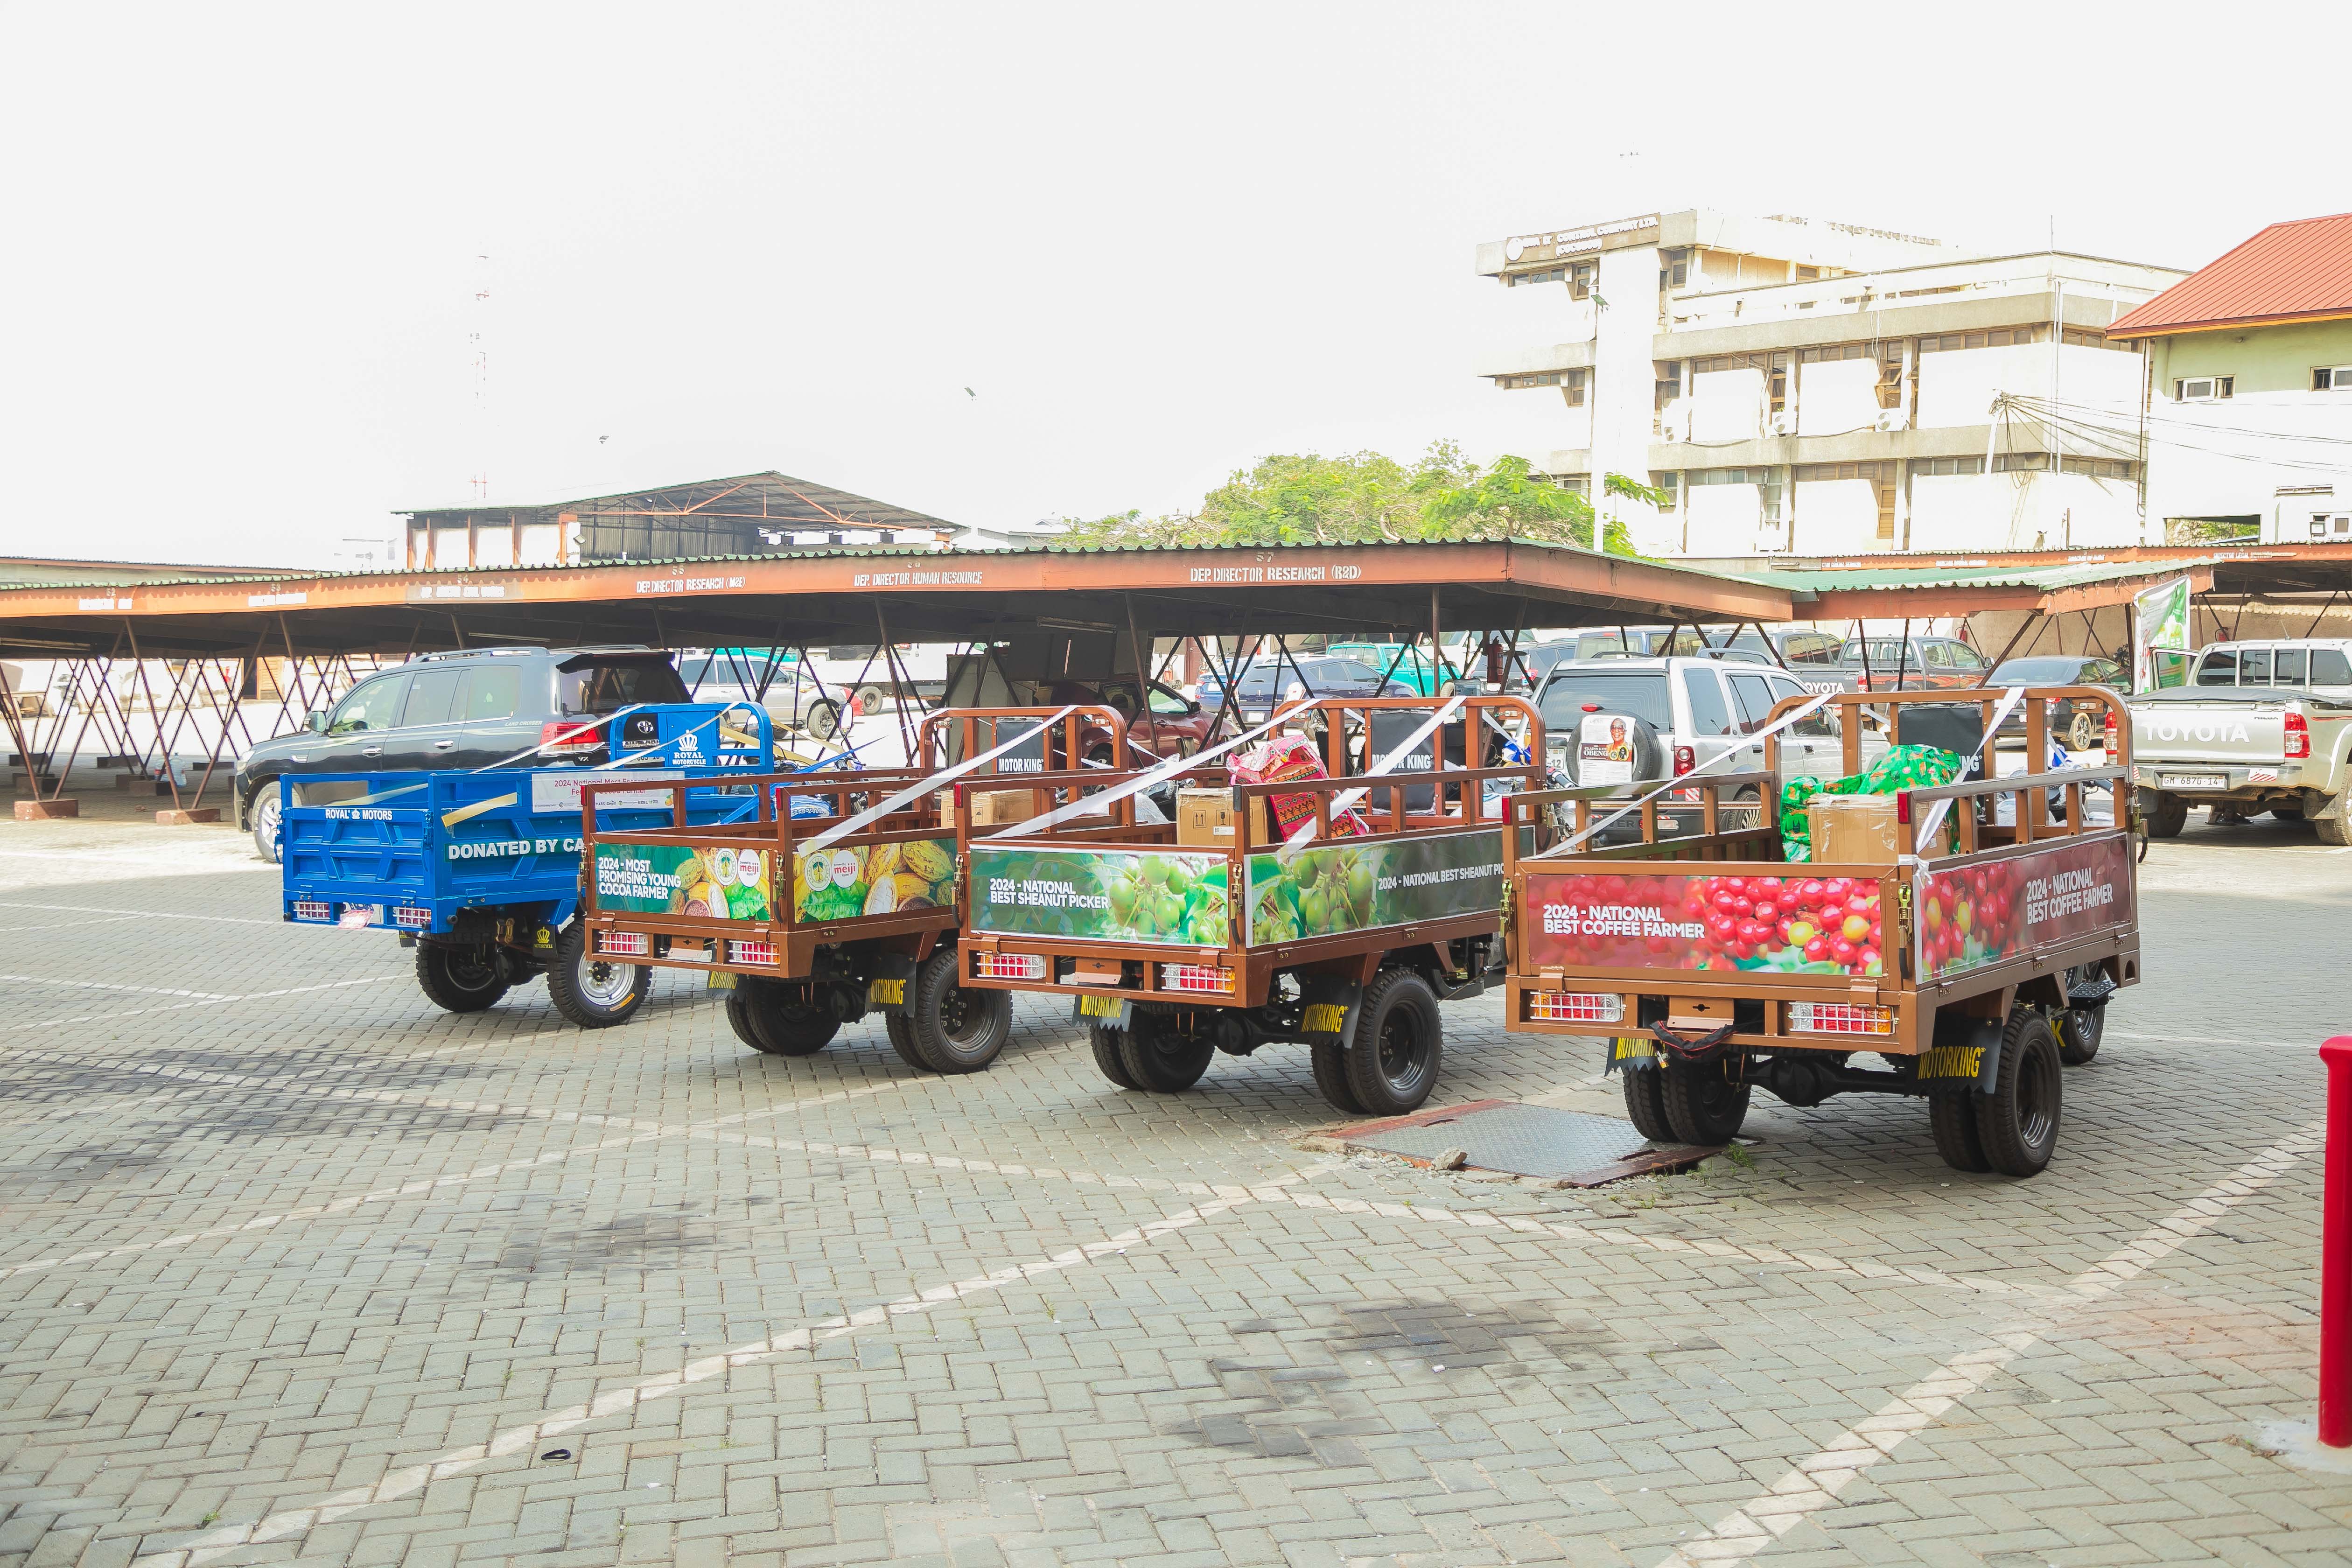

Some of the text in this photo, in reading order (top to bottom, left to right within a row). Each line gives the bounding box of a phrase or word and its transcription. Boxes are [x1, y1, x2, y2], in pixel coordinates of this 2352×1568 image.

[1256, 552, 1274, 562] 57
[672, 565, 684, 575] 55
[1190, 567, 1211, 582] DEP.
[1213, 567, 1263, 582] DIRECTOR
[1267, 567, 1325, 581] RESEARCH
[637, 581, 651, 593] DEP.
[651, 579, 684, 593] DIRECTOR
[686, 577, 724, 590] RESEARCH
[854, 571, 983, 587] DEP. DIRECTOR HUMAN RESOURCE
[1804, 682, 1845, 694] OYOTA
[2142, 723, 2250, 742] TOYOTA
[999, 758, 1023, 772] MOTOR
[362, 810, 392, 820] MOTORS
[448, 840, 531, 859] DONATED
[536, 839, 558, 854] BY
[598, 857, 619, 870] 2024
[626, 859, 651, 872] MOST
[740, 863, 759, 875] meiji
[834, 862, 856, 875] meiji
[599, 870, 681, 888] PROMISING YOUNG
[1378, 876, 1398, 890] 2024
[1403, 871, 1440, 887] NATIONAL
[1441, 868, 1459, 882] BEST
[1460, 864, 1493, 880] SHEANUT
[1493, 862, 1505, 875] PIC
[598, 882, 668, 900] COCOA FARMER
[989, 878, 1015, 891] 2024
[1023, 880, 1076, 895] NATIONAL
[2027, 878, 2048, 902] 2024
[2052, 867, 2093, 896] NATIONAL
[991, 891, 1110, 909] BEST SHEANUT PICKER
[2027, 883, 2113, 925] BEST COFFEE FARMER
[1543, 904, 1578, 920] 2024
[1589, 905, 1665, 922] NATIONAL
[1544, 919, 1705, 938] BEST COFFEE FARMER
